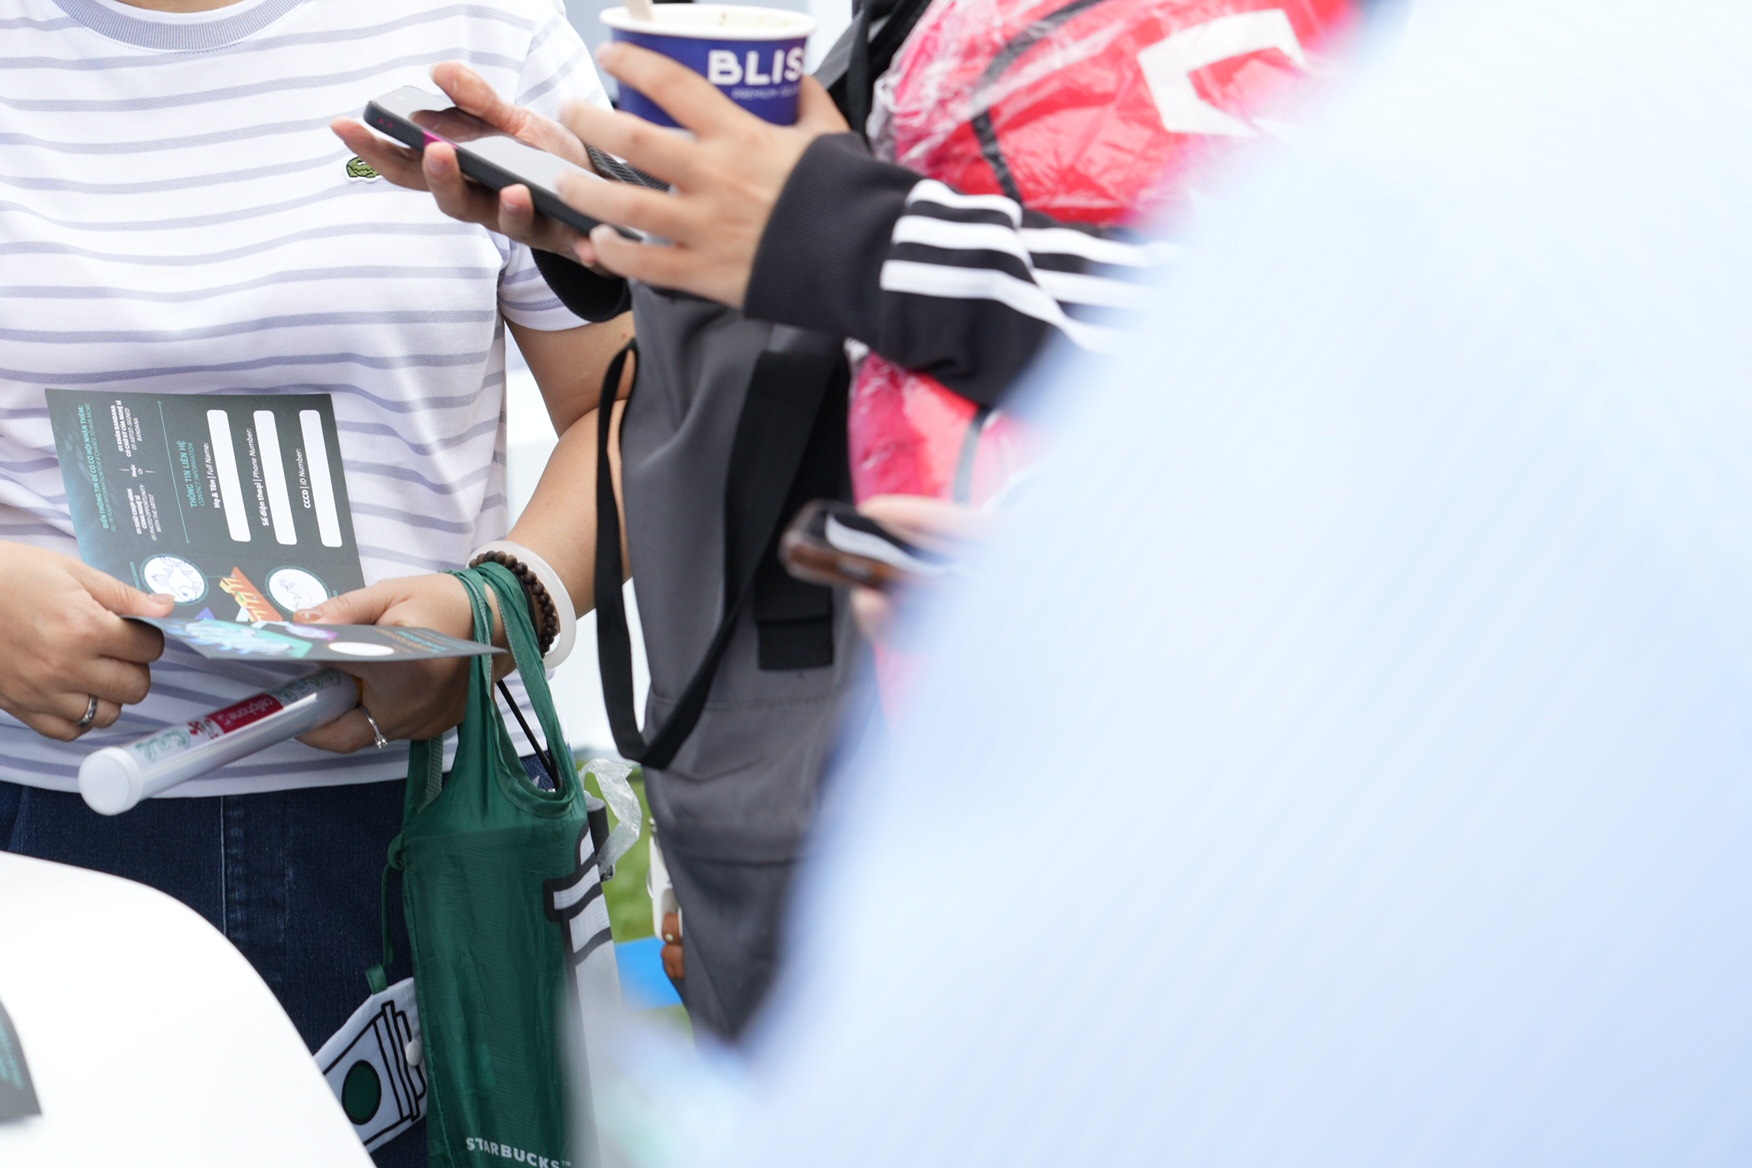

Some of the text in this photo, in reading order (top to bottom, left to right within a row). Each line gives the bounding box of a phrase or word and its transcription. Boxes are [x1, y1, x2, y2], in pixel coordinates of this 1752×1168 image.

[246, 428, 256, 457] Number:
[204, 442, 212, 464] Name:
[296, 448, 305, 477] Number:
[176, 441, 197, 508] THÔNG TIN LIÊN HỆ
[205, 464, 214, 476] Full
[251, 457, 260, 478] Phone
[209, 479, 217, 491] Tên
[213, 498, 221, 508] Họ
[302, 489, 311, 509] CCCD
[260, 516, 269, 526] Số
